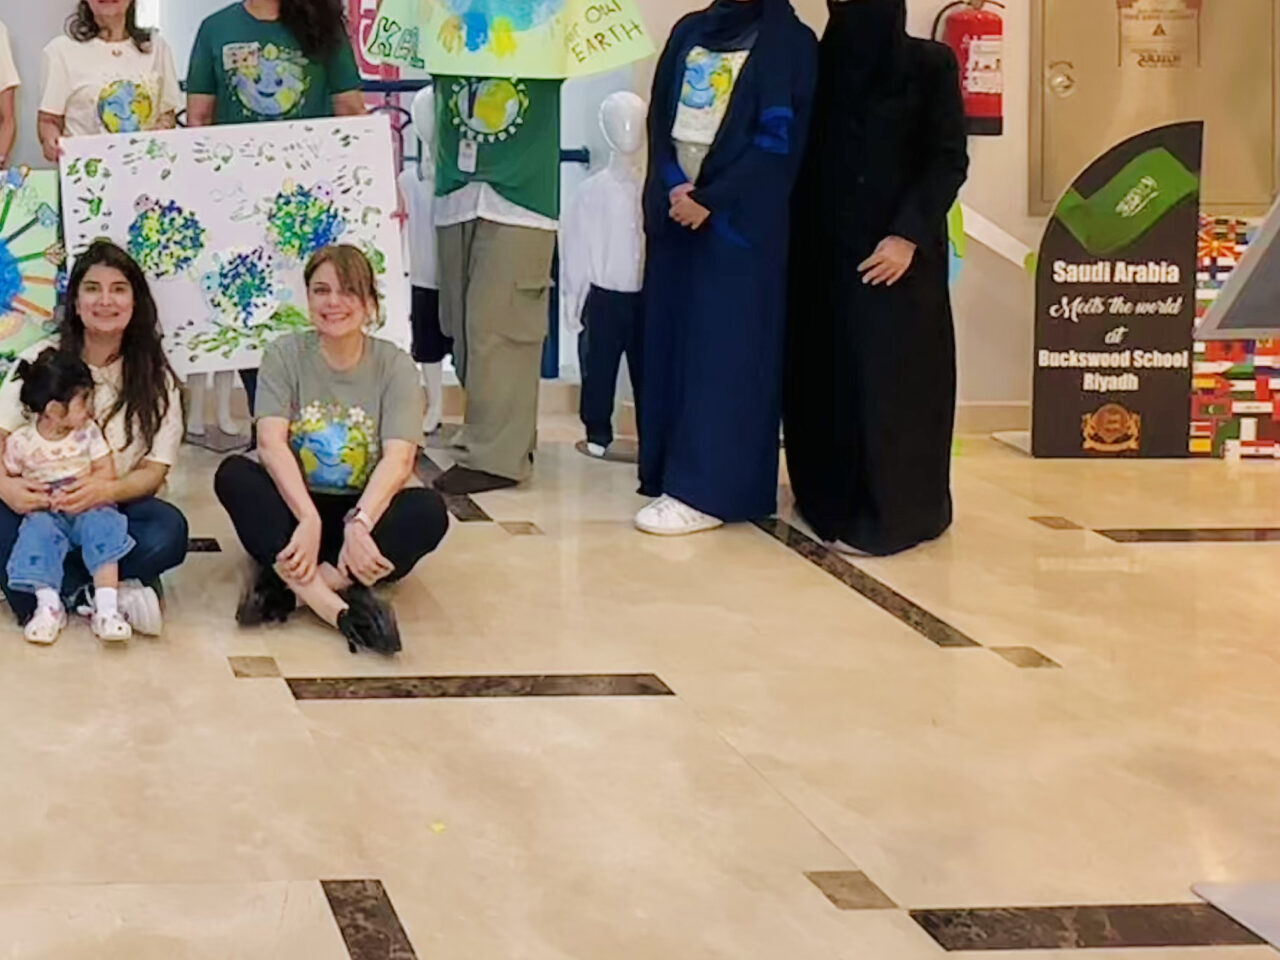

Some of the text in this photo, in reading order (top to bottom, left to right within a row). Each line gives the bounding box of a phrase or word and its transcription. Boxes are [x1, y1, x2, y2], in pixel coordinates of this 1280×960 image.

[571, 19, 644, 63] EARTH
[1052, 259, 1181, 283] Saudi Arabia
[1049, 295, 1183, 323] Meets the world
[1104, 326, 1129, 344] at
[1038, 349, 1189, 369] Buckswood School
[1082, 372, 1139, 392] Riyadh
